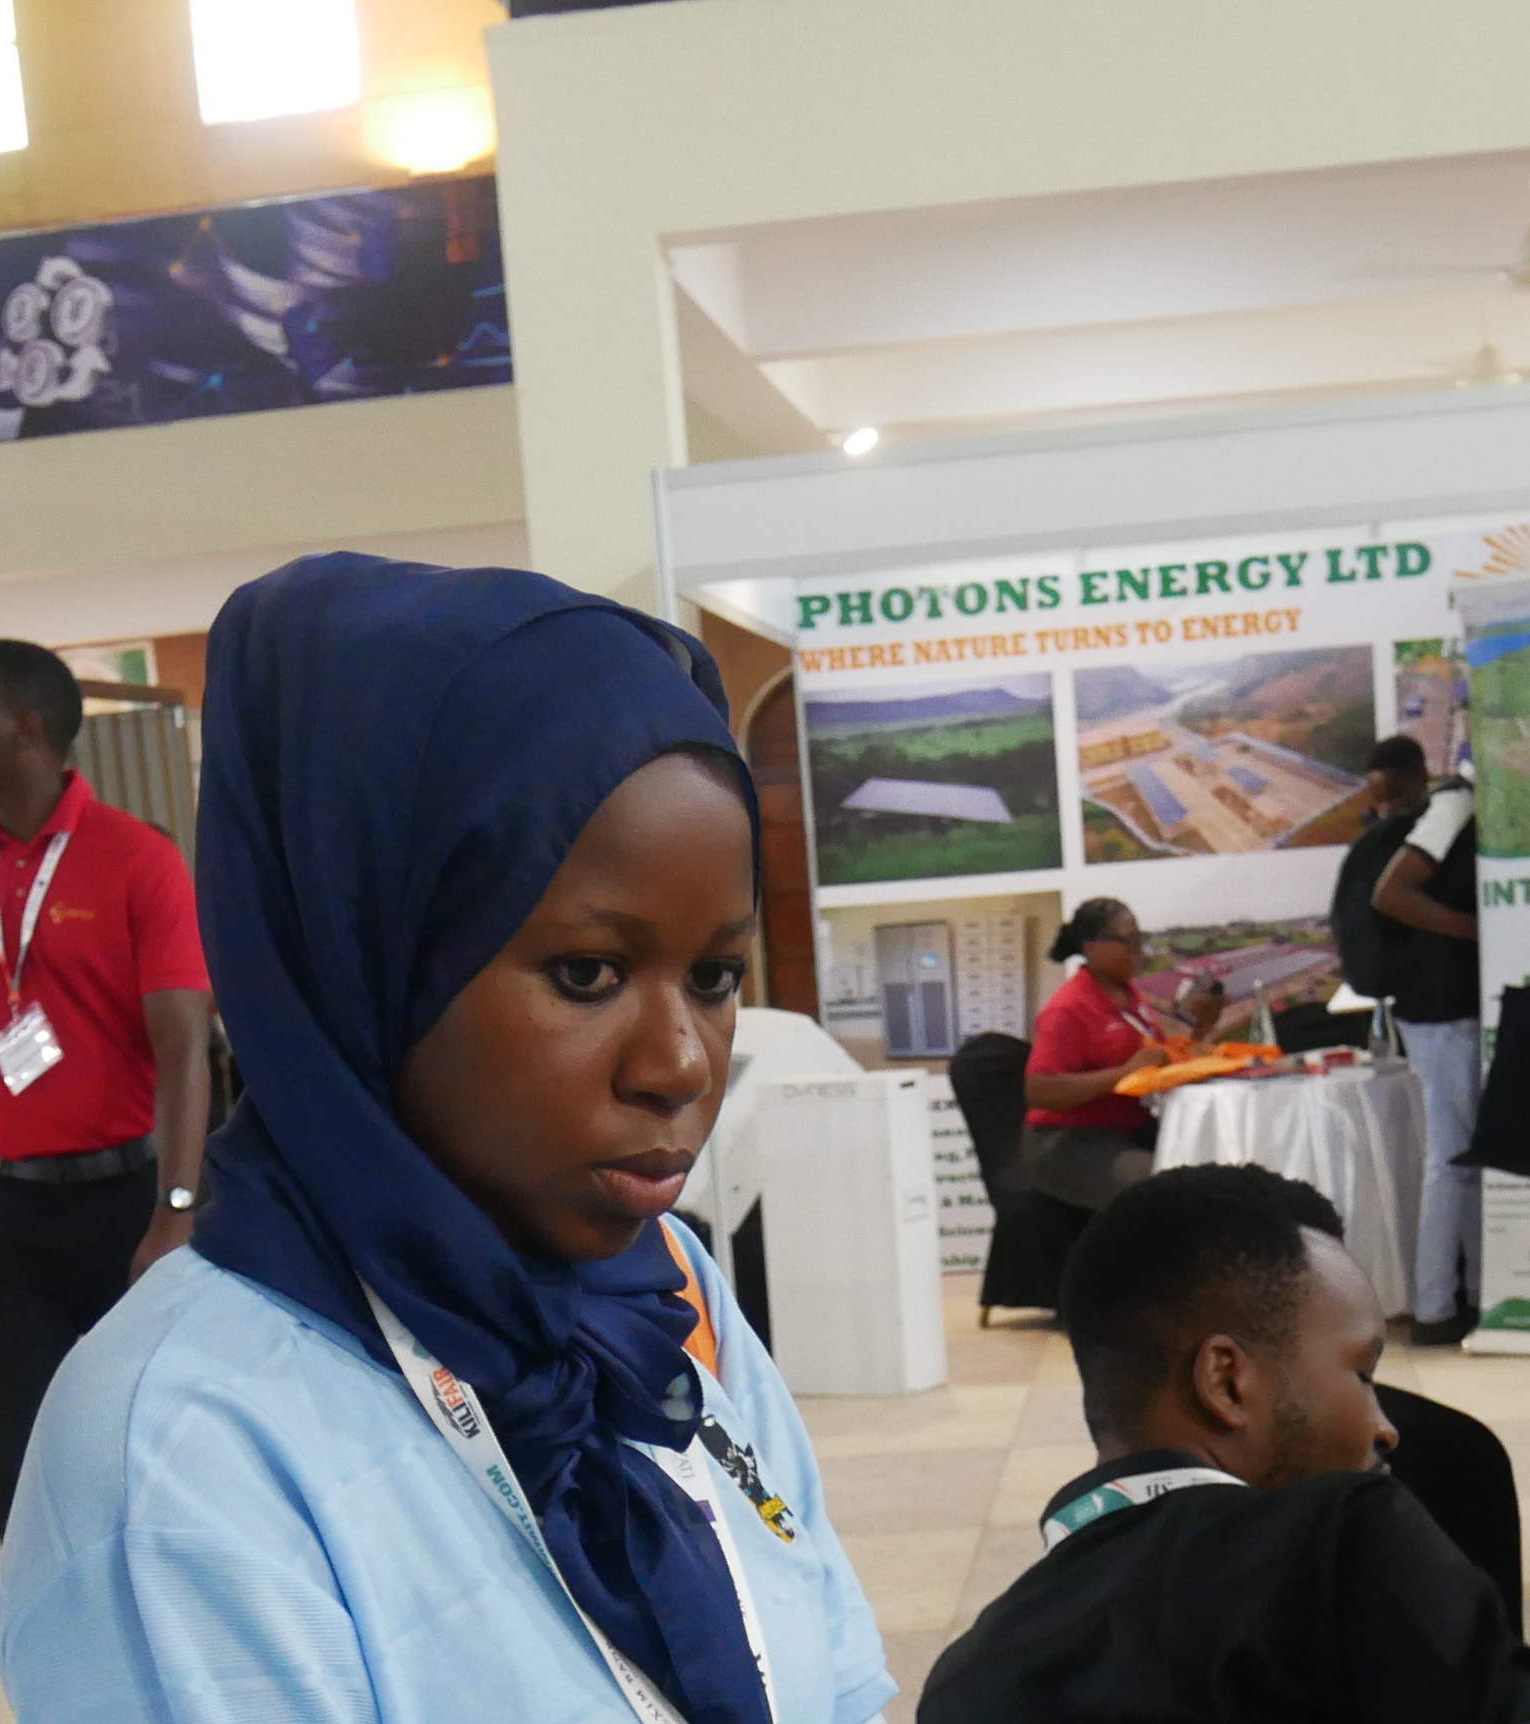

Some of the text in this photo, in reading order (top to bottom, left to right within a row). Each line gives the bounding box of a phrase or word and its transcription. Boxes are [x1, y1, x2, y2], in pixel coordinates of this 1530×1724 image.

[797, 541, 1433, 630] PHOTONS ENERGY LTD
[797, 608, 1303, 674] WHERE NATURE TURNS TO ENERGY
